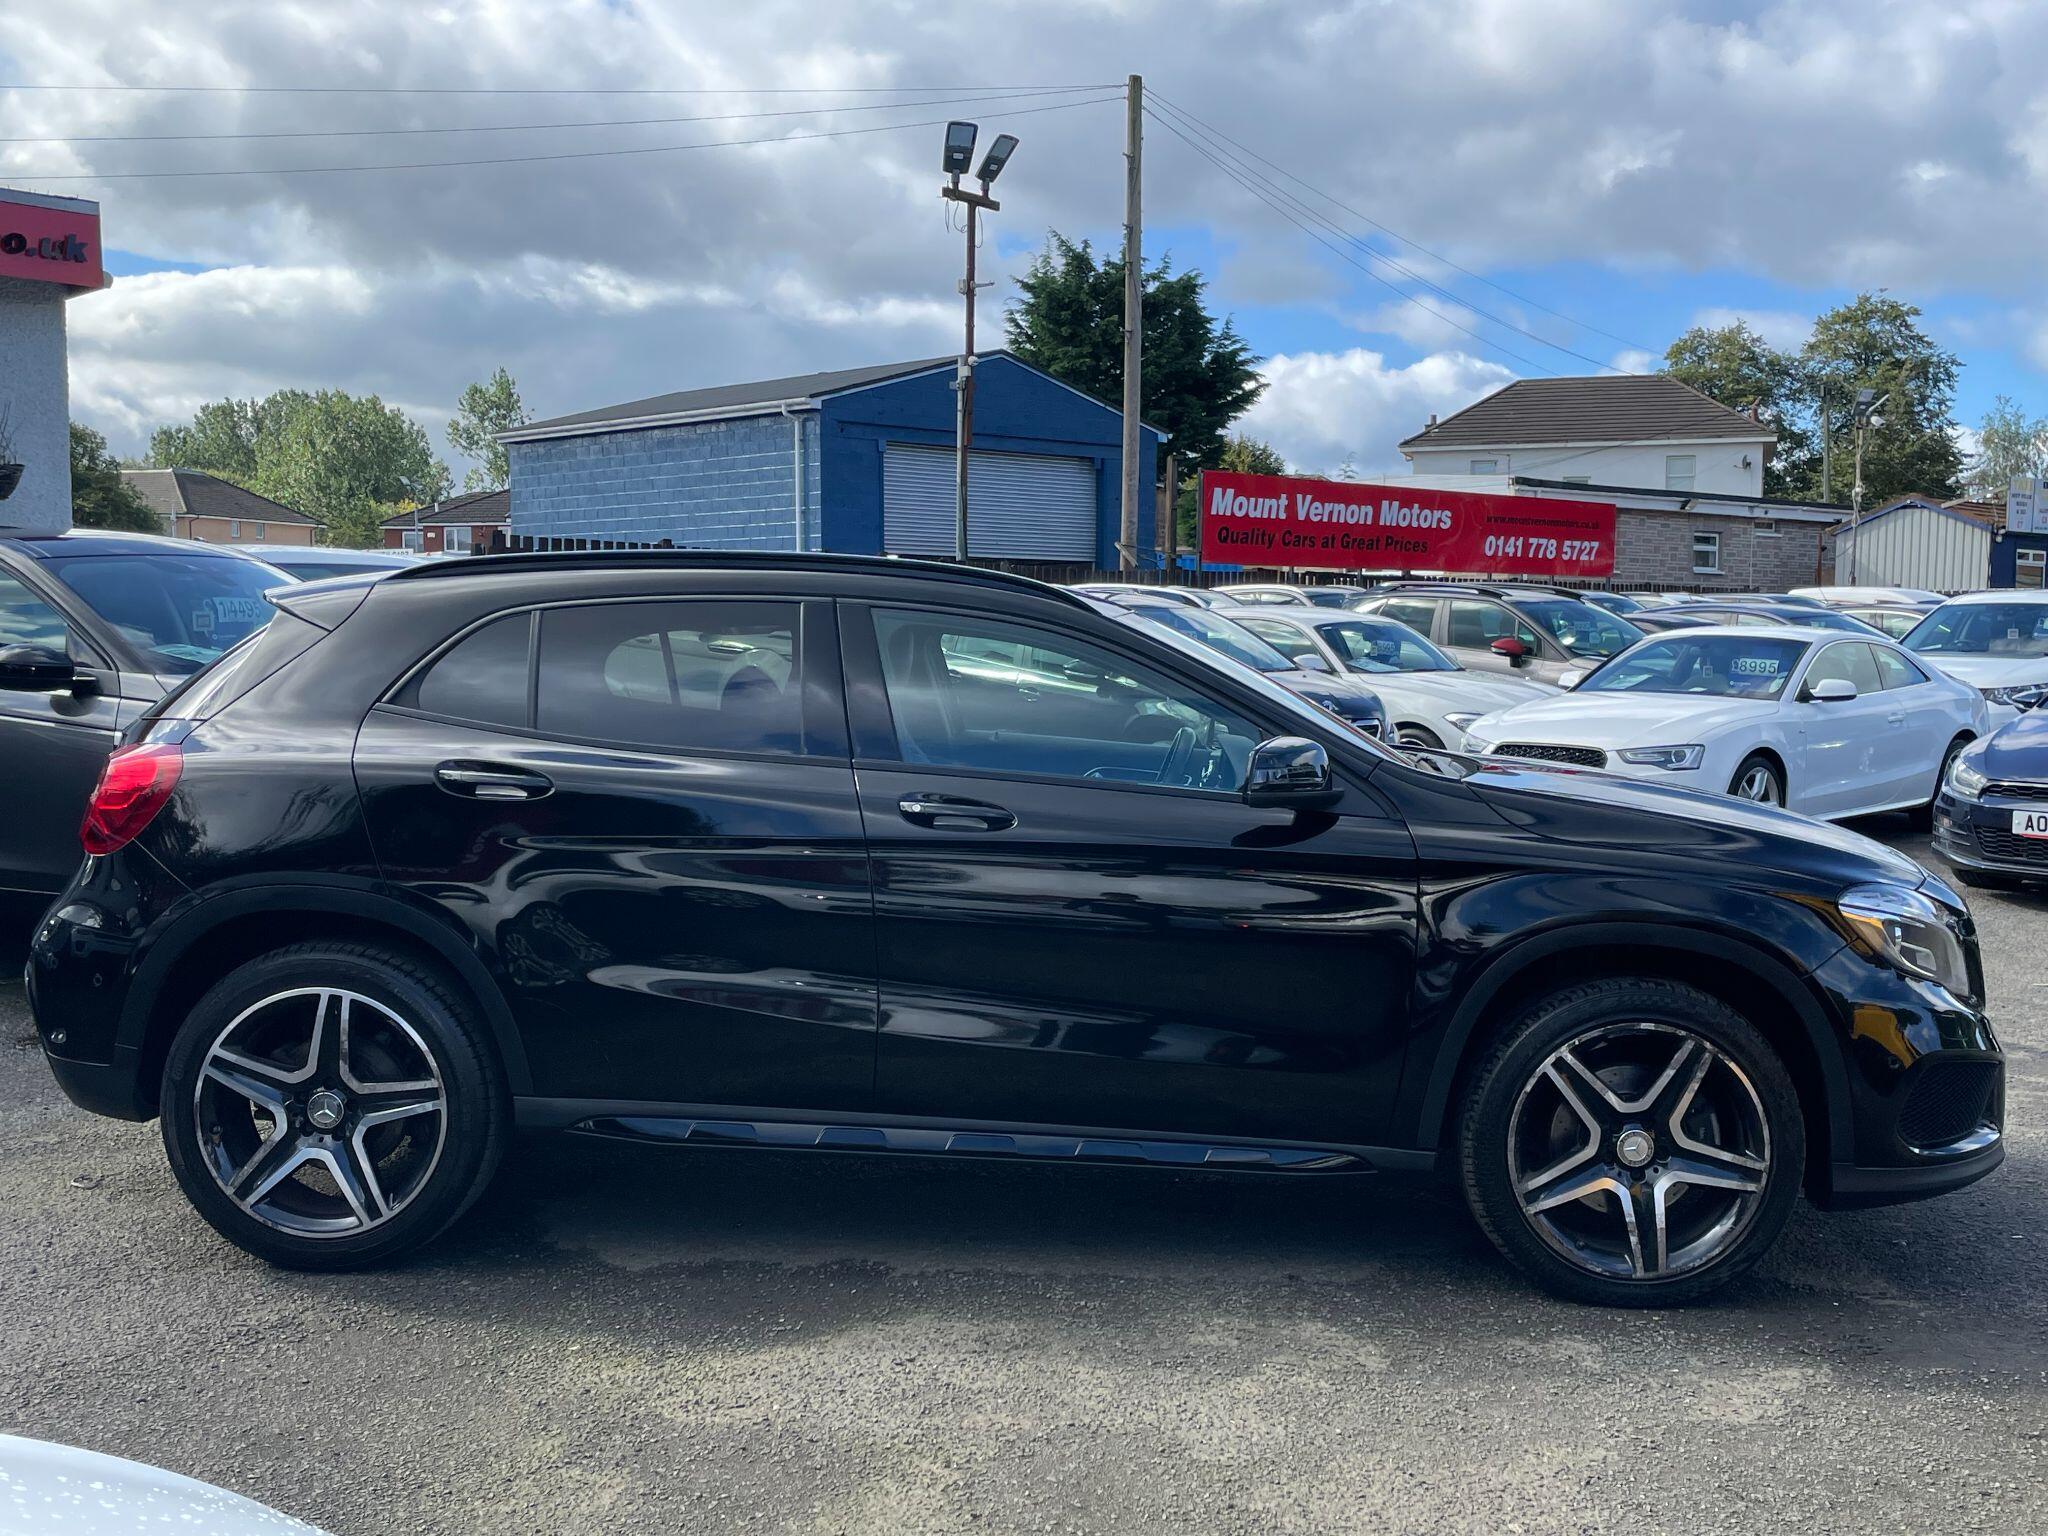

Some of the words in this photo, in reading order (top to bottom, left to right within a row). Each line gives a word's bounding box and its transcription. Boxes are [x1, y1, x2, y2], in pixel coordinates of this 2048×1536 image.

[1210, 487, 1288, 520] Mount
[1296, 493, 1373, 525] Vernon
[1379, 500, 1452, 530] Motors
[1217, 526, 1276, 550] Quality
[1281, 529, 1316, 549] Cars
[1321, 533, 1336, 549] at
[1341, 533, 1380, 551] Great
[1384, 535, 1428, 554] Prices
[1484, 535, 1523, 557] 0141
[1528, 537, 1557, 559] 778
[1561, 540, 1600, 561] 5727
